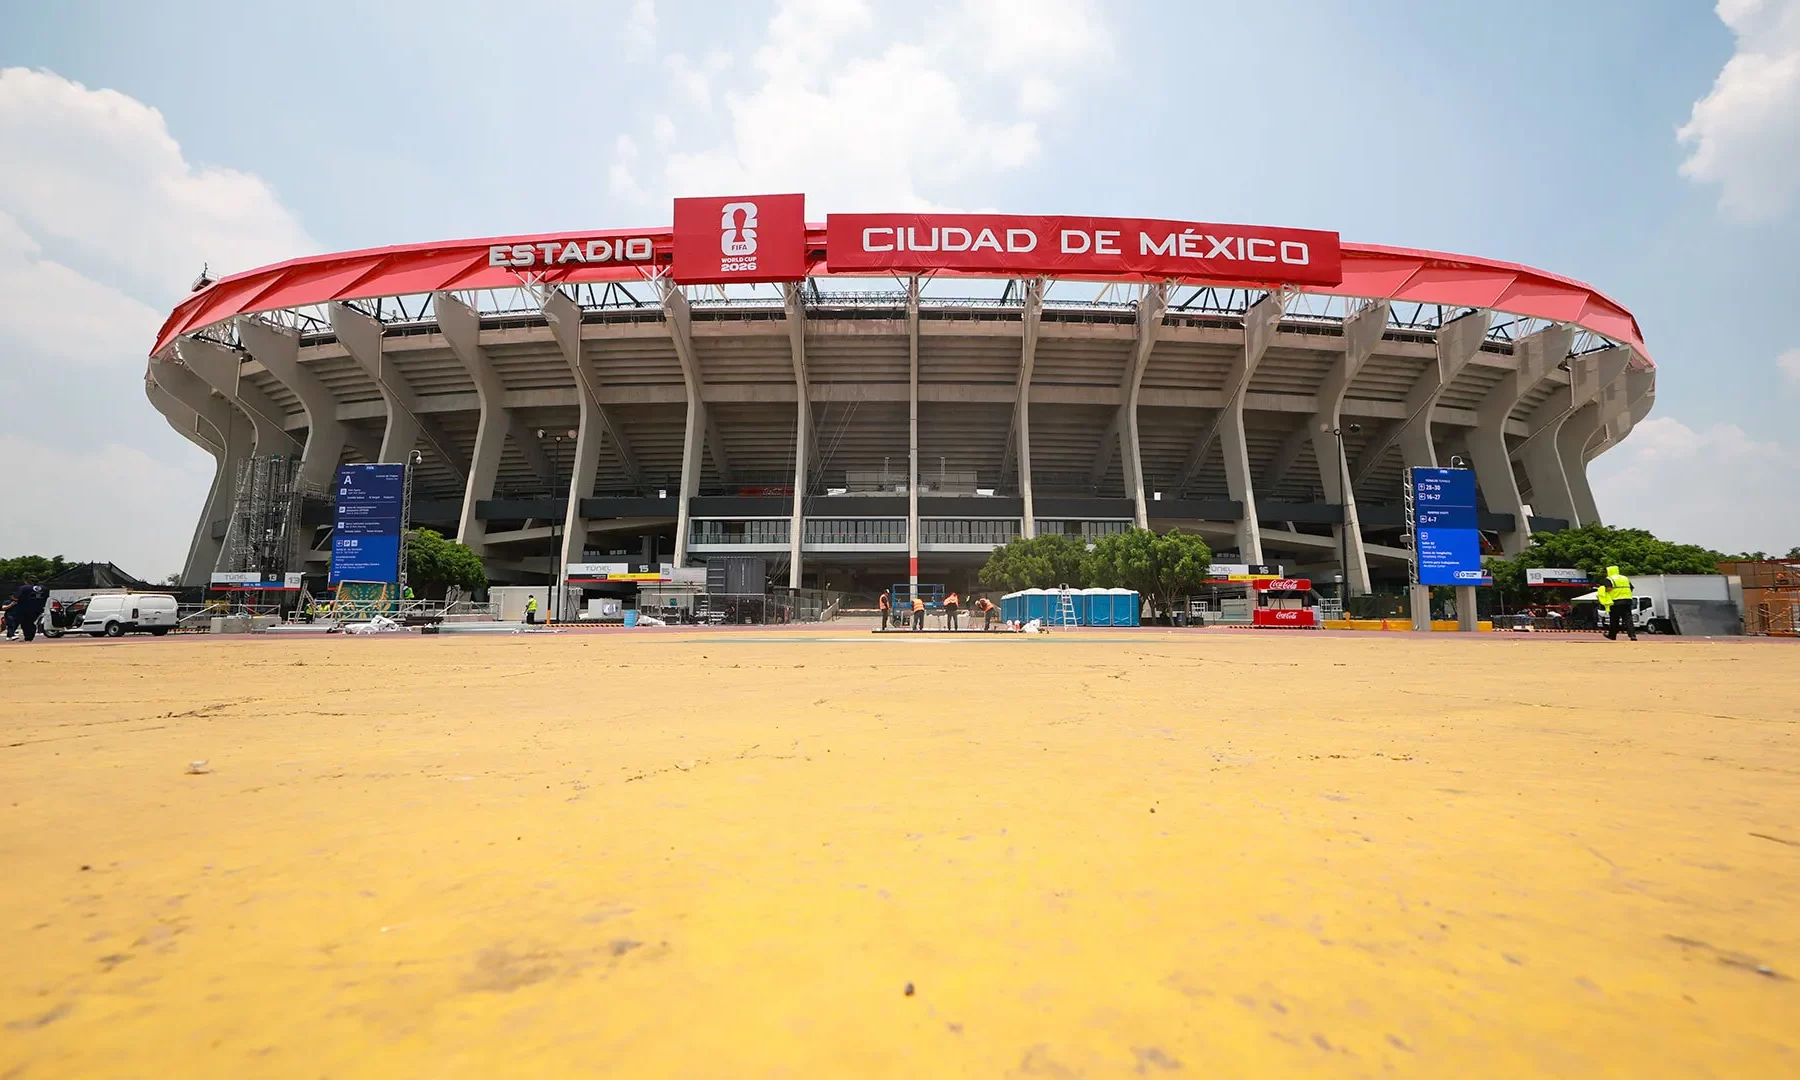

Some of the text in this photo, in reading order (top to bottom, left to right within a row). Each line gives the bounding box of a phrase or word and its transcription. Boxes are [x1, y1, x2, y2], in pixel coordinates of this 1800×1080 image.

[862, 227, 1310, 266] CIUDAD DE MÉXICO
[489, 238, 653, 267] ESTADIO
[720, 262, 757, 272] 2026
[343, 475, 352, 485] A
[638, 565, 649, 573] 15
[1258, 566, 1269, 574] 16
[268, 573, 278, 582] 13
[288, 576, 300, 585] 13
